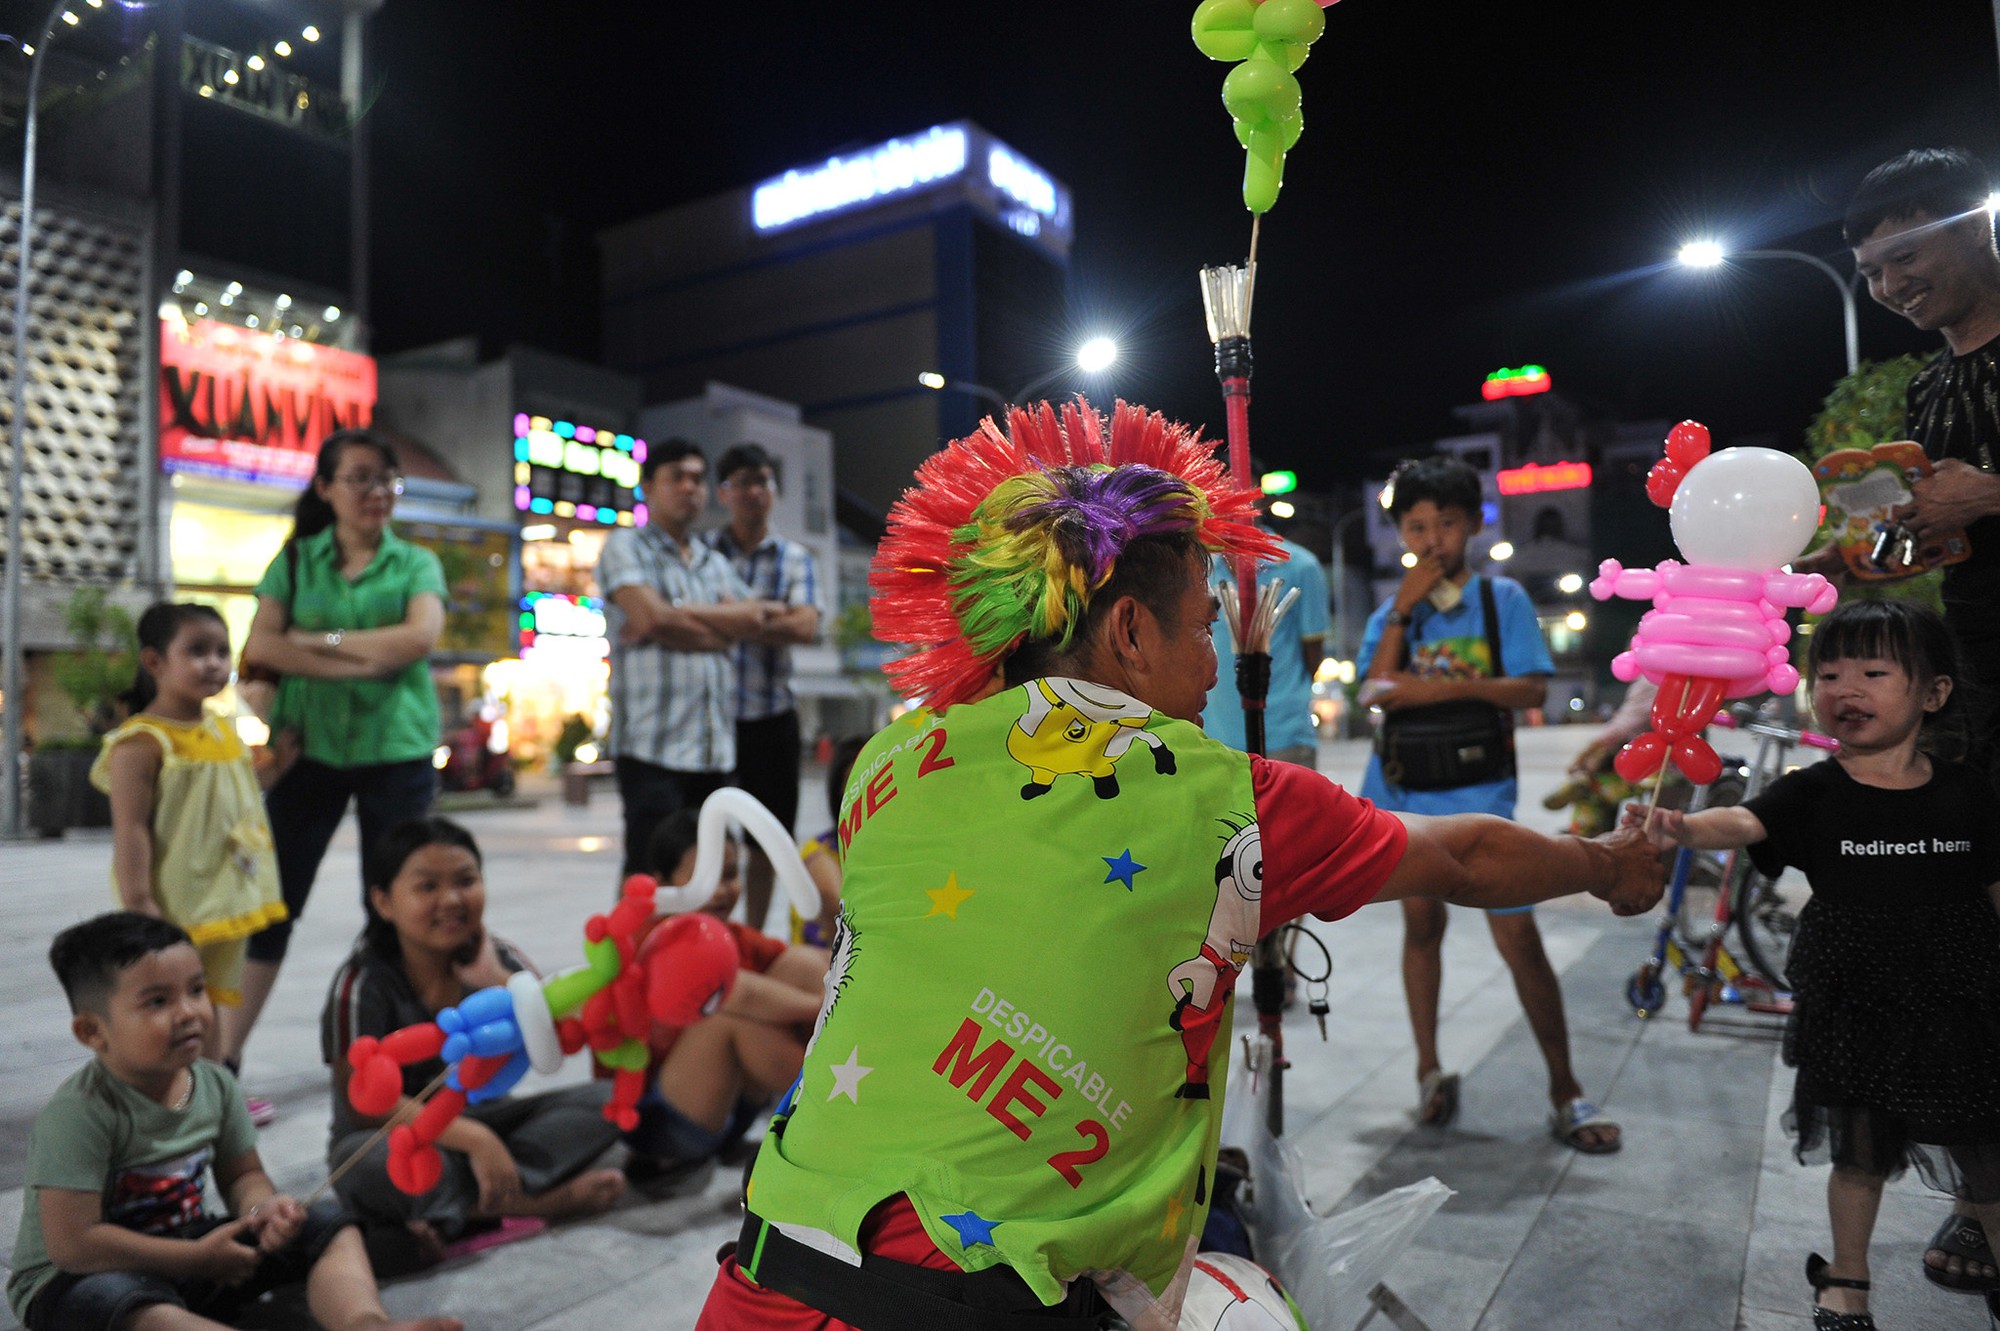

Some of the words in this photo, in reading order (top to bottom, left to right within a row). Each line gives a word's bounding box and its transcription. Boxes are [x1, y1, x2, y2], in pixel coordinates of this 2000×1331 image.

[838, 760, 898, 862] ME
[914, 728, 955, 778] 2
[1840, 840, 1926, 855] Redirect
[932, 1016, 1063, 1142] ME
[1046, 1119, 1110, 1189] 2
[970, 986, 1133, 1131] DESPICABLE
